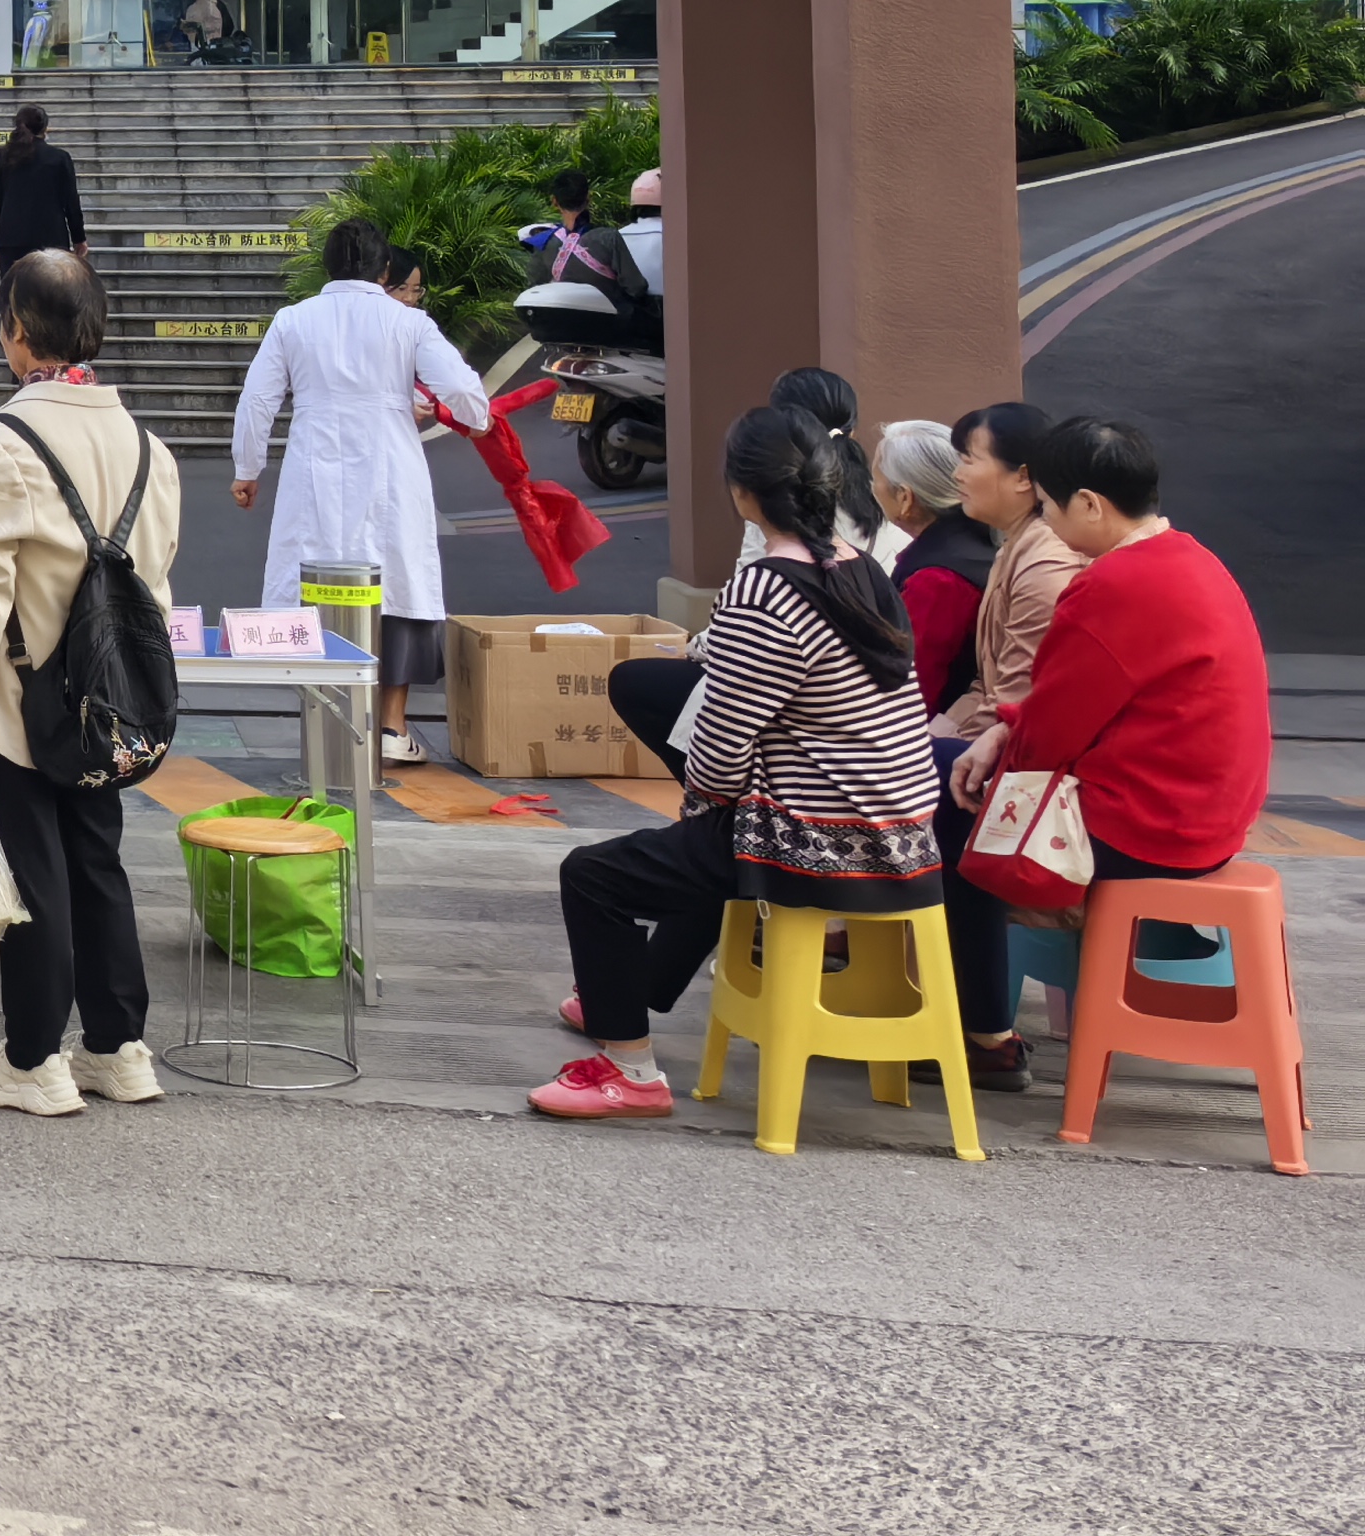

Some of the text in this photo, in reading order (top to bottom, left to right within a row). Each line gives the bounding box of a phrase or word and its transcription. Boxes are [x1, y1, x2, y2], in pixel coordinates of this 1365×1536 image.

[175, 232, 298, 247] 小心台阶 防止跌倒
[189, 321, 249, 336] 小心台阶
[241, 623, 310, 646] 测血糖
